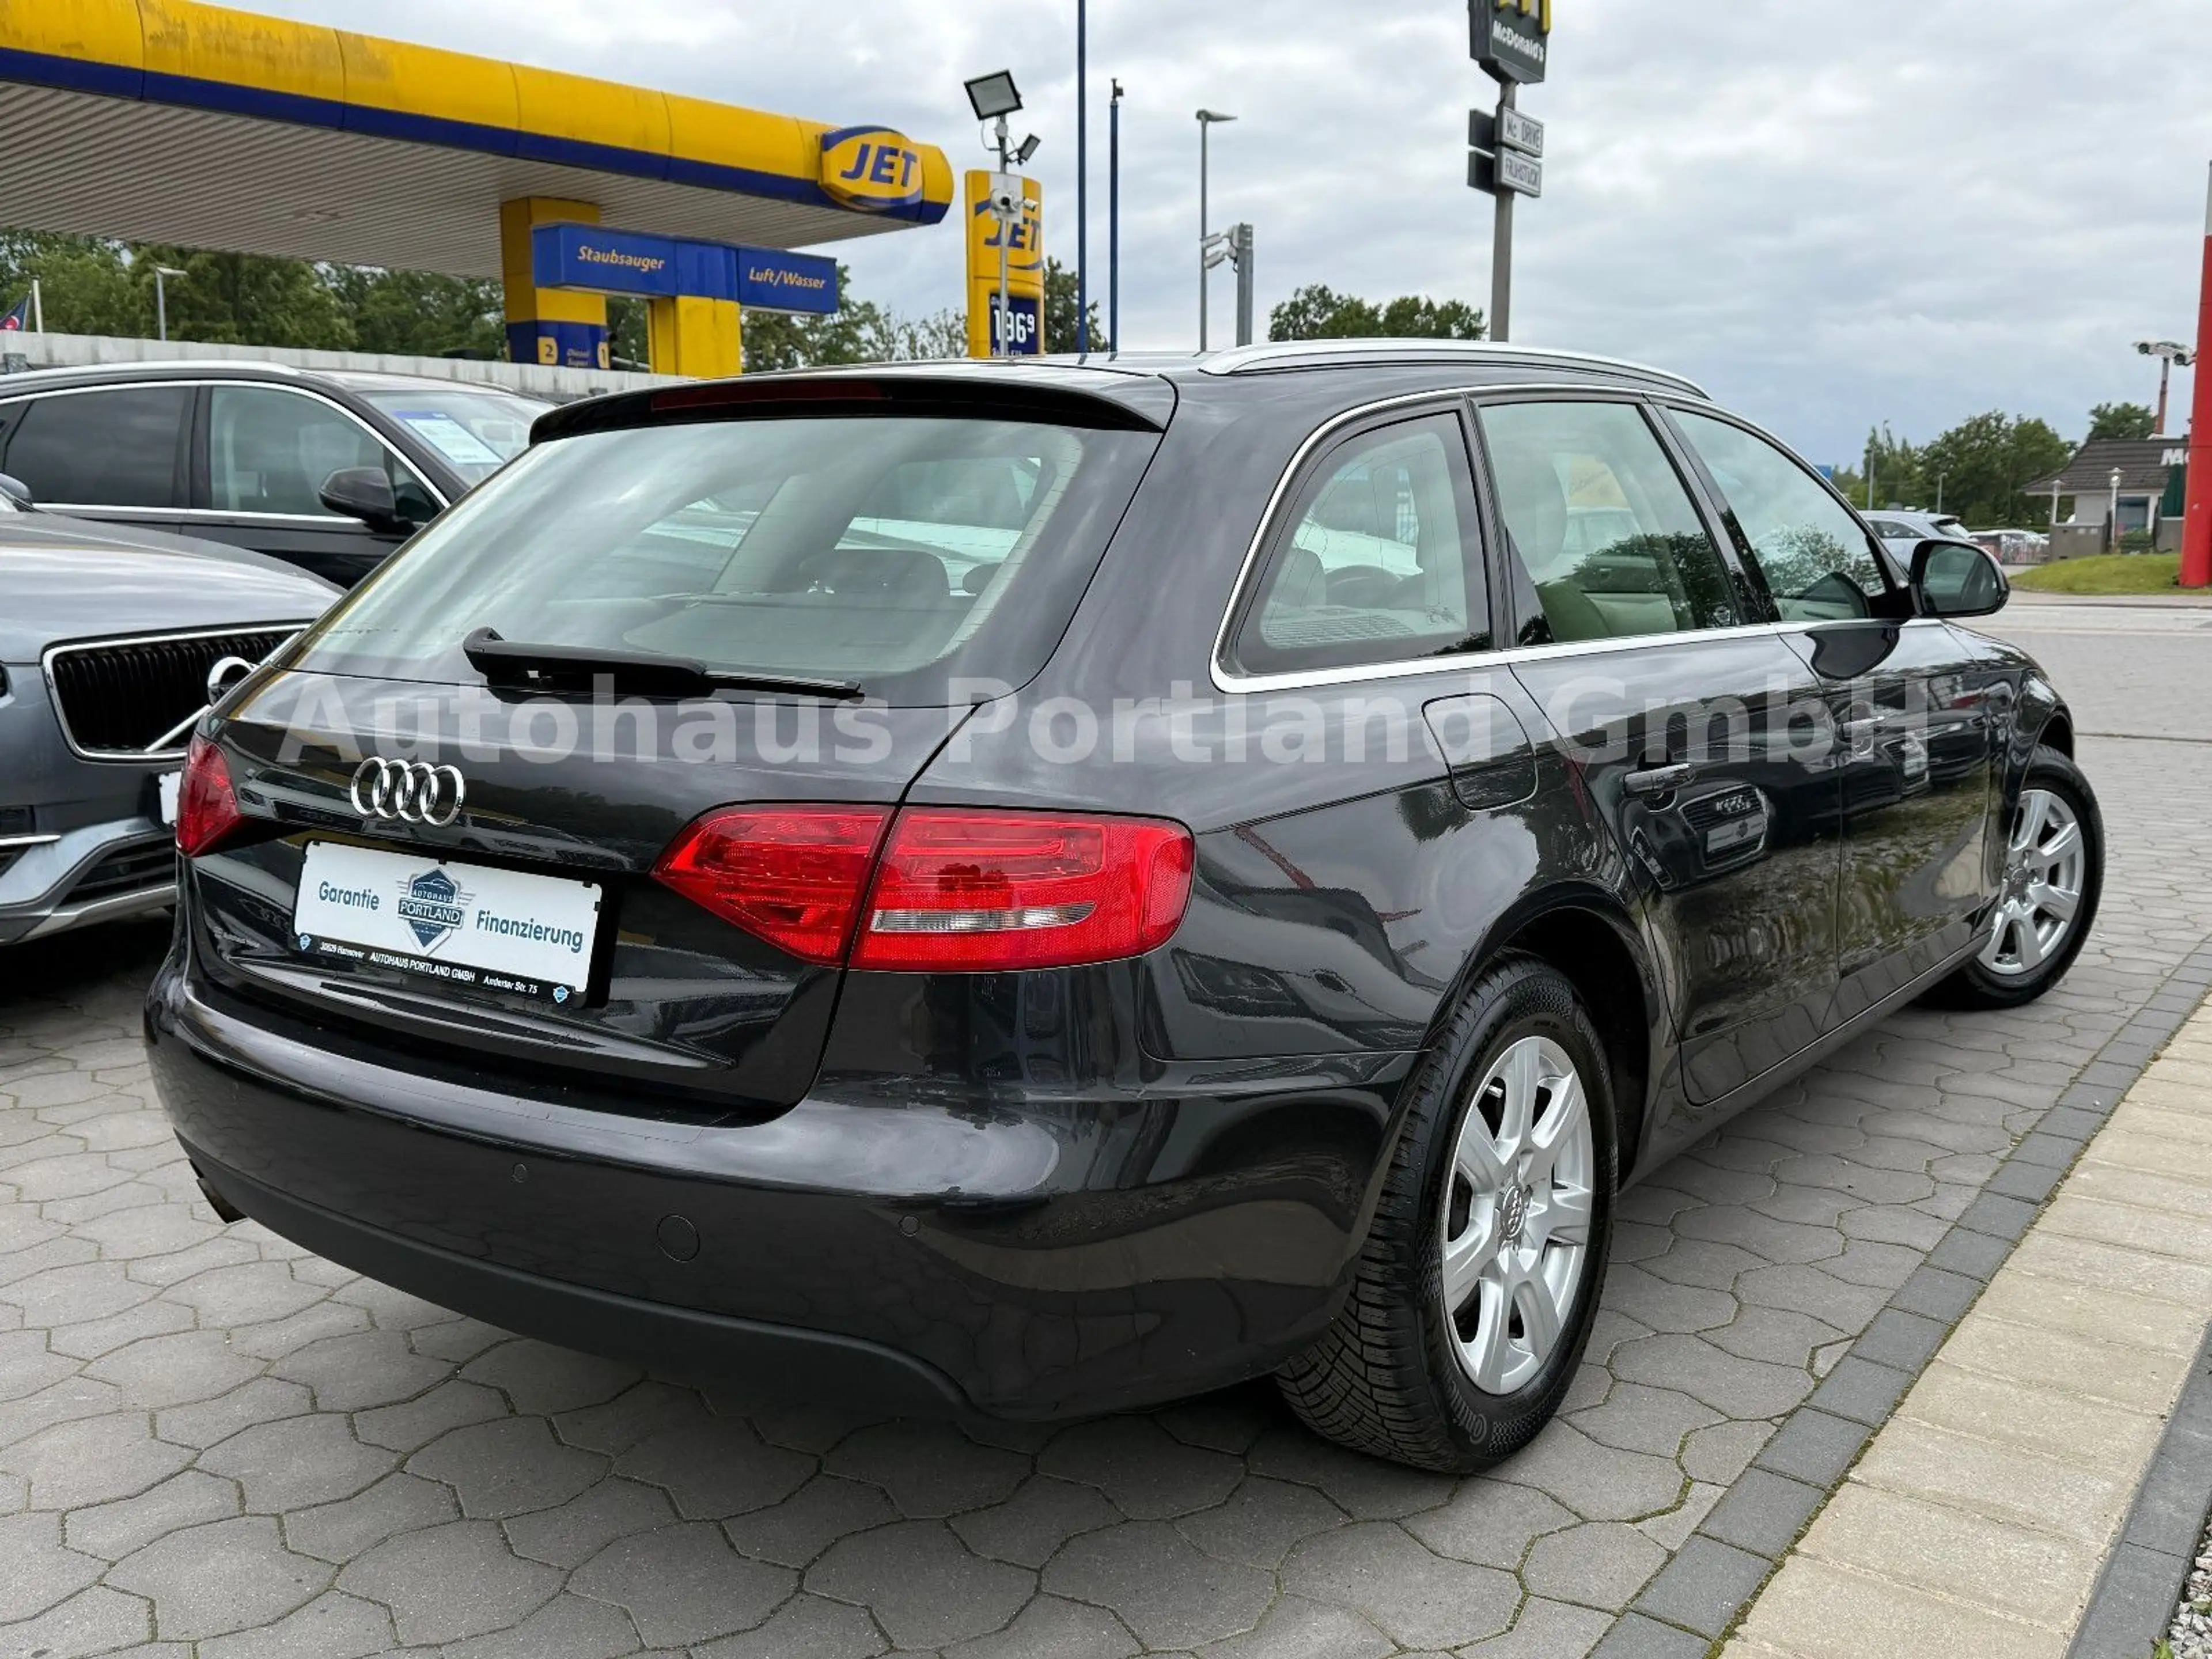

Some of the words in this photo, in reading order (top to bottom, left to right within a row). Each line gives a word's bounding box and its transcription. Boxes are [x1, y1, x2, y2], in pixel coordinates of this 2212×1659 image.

[1493, 20, 1544, 62] McDonald's
[840, 143, 918, 187] JET
[984, 218, 1041, 251] JET
[577, 245, 665, 272] Staubsauger
[749, 267, 827, 288] Luft/Wasser
[545, 344, 554, 357] 2
[319, 881, 380, 911] Garantie
[412, 889, 453, 903] AUTOHAUS
[400, 900, 460, 922] PORTLAND
[476, 909, 583, 953] Finanzierung
[337, 945, 365, 959] Hannover
[369, 952, 408, 969] AUTOHAUS
[409, 960, 450, 976] PORTLAND
[528, 984, 539, 994] 75
